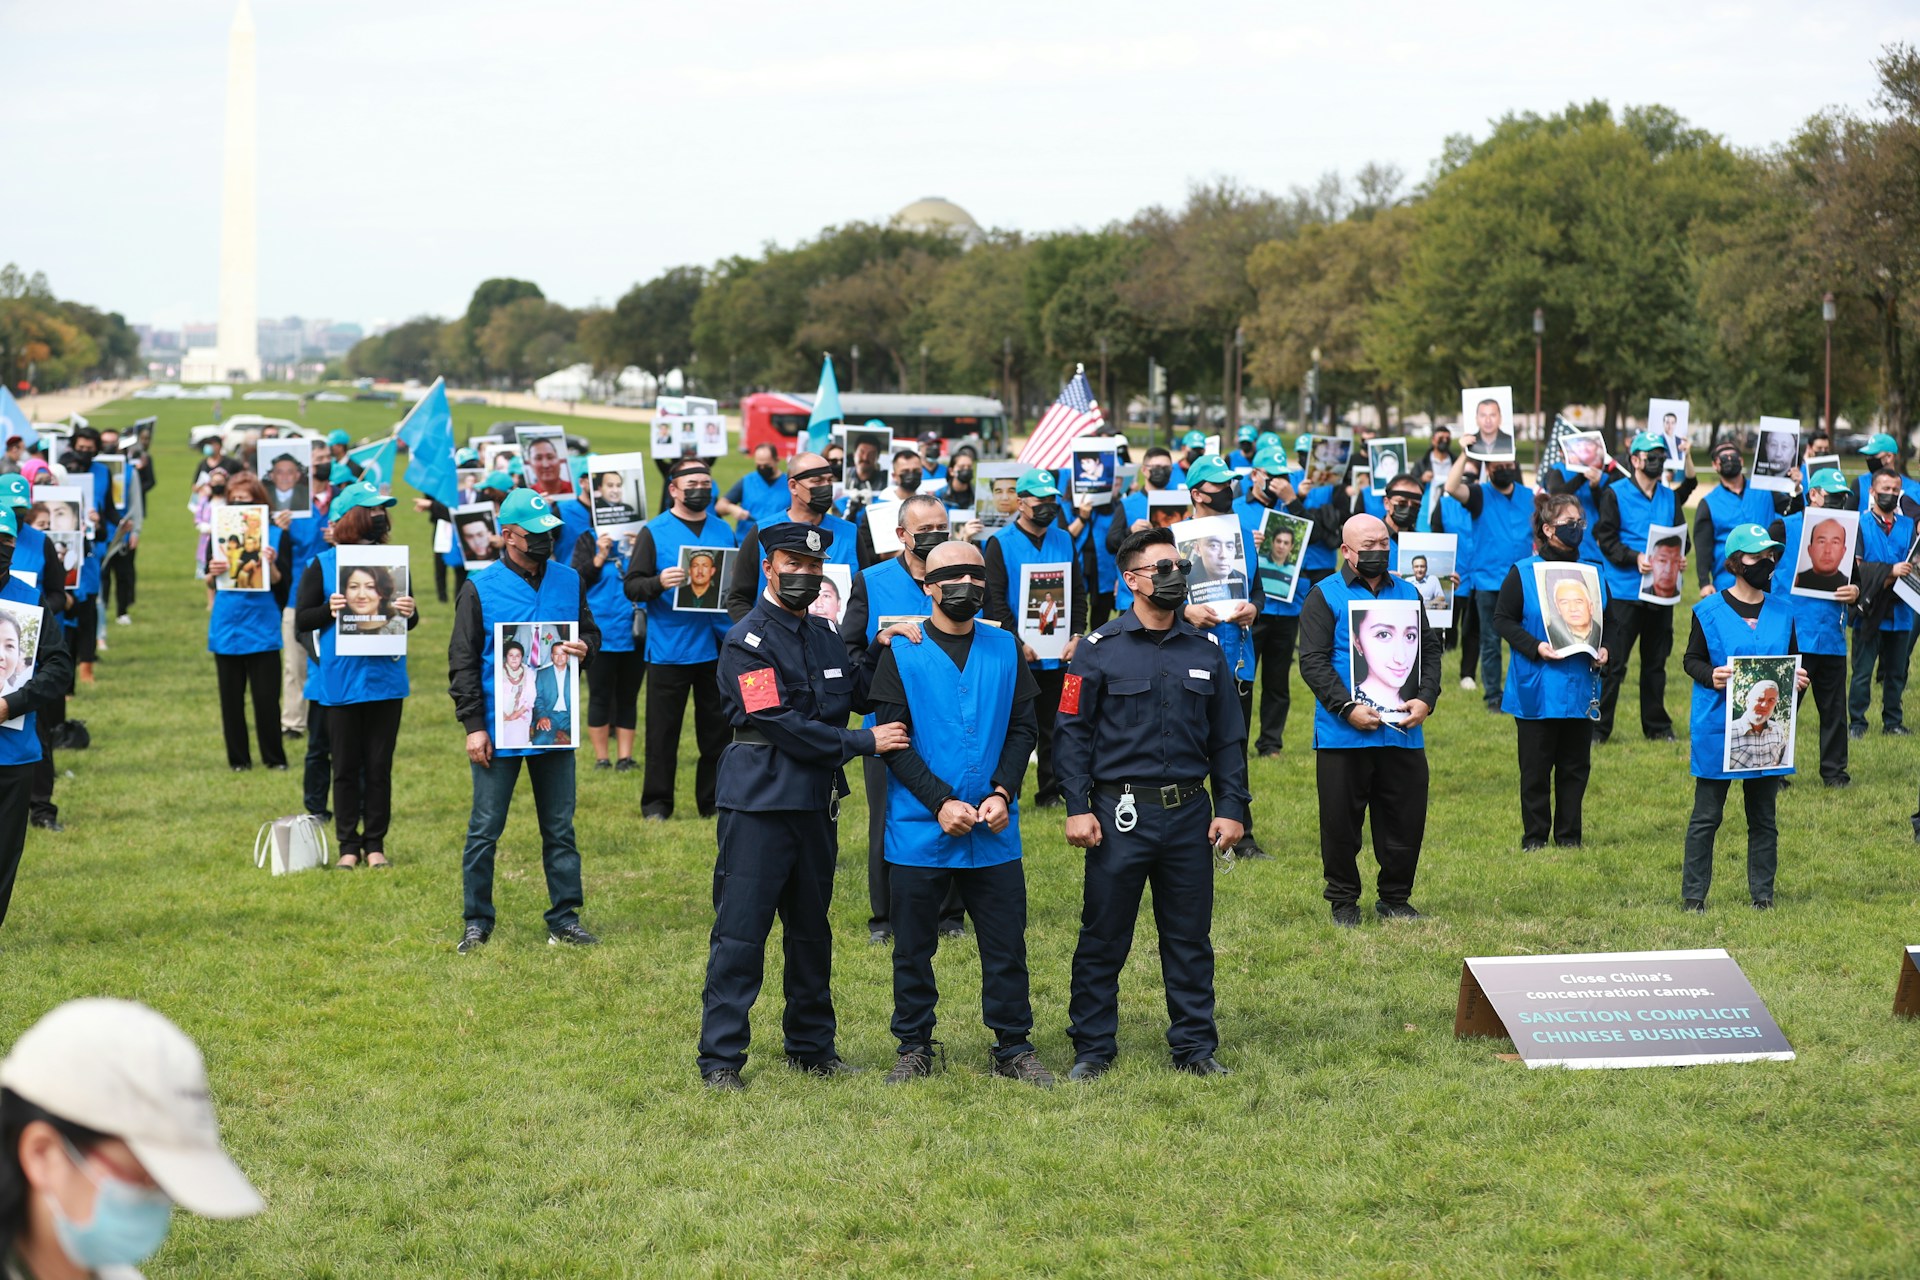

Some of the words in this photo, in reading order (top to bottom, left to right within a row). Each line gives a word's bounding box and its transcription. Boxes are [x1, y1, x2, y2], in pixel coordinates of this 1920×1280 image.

[343, 623, 357, 631] POET
[1560, 973, 1607, 984] Close
[1610, 972, 1673, 983] China's
[1526, 987, 1650, 1000] concentration
[1653, 987, 1715, 999] camps.
[1518, 1009, 1632, 1024] SANCTION
[1637, 1007, 1751, 1022] COMPLICIT
[1532, 1029, 1626, 1043] CHINESE
[1628, 1026, 1763, 1042] BUSINESSES!
